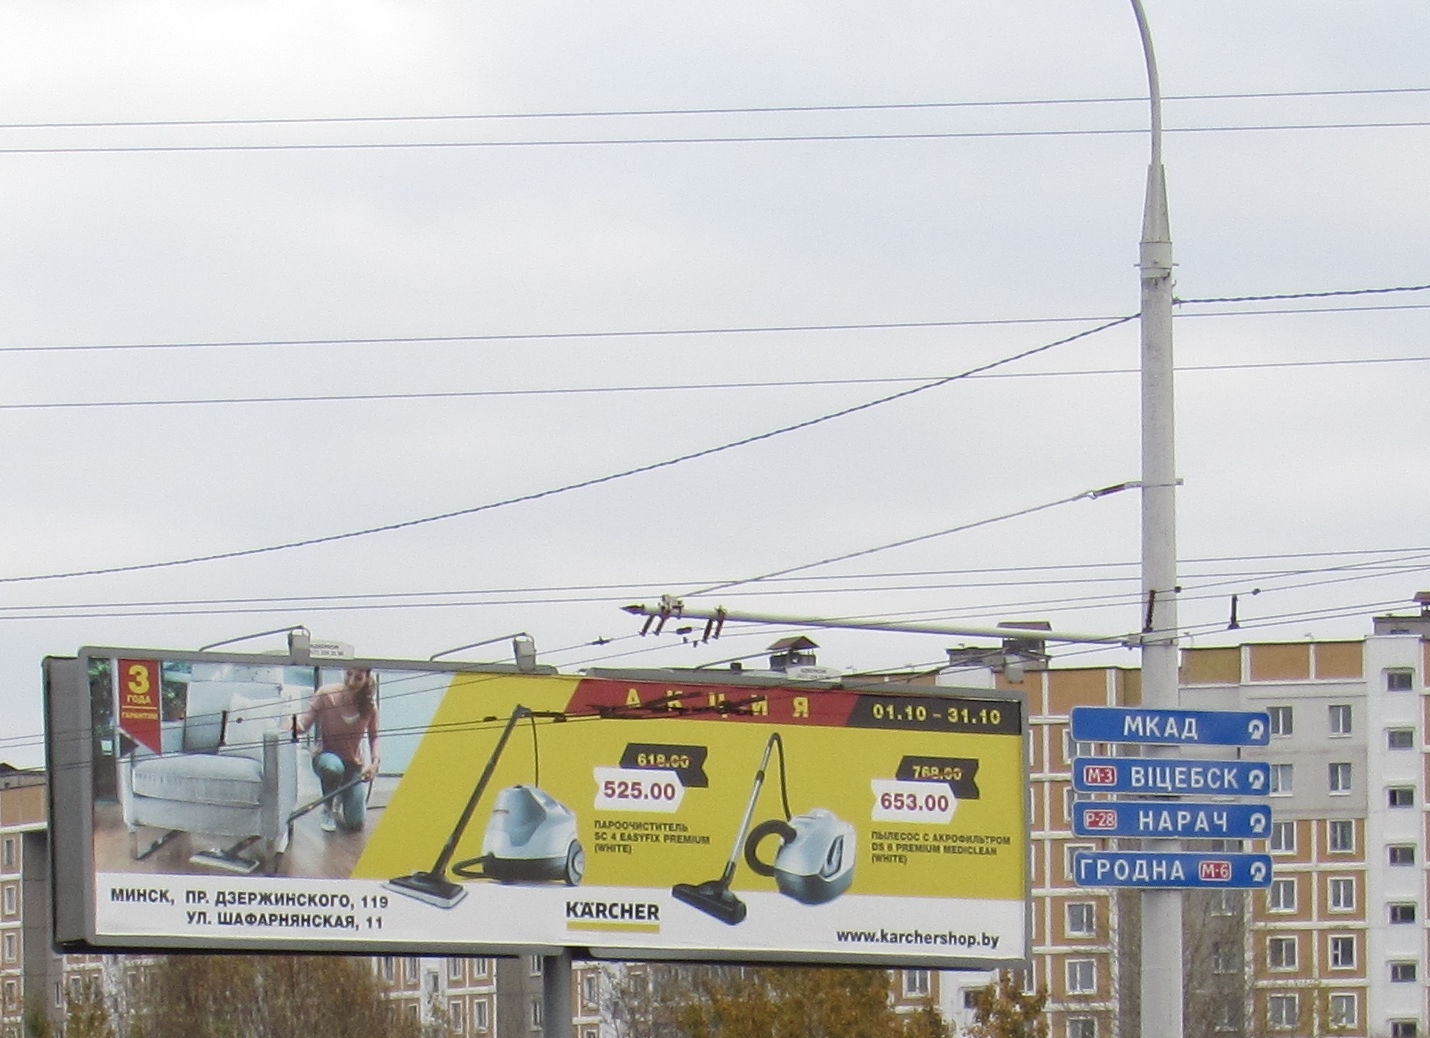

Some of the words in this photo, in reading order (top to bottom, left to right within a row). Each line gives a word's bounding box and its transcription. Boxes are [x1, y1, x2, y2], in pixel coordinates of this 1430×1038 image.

[127, 664, 150, 694] 3
[126, 694, 152, 705] ГОДА
[872, 703, 927, 722] 01.10
[947, 707, 1001, 724] 31.10
[1123, 715, 1199, 740] МКАД
[1087, 768, 1113, 783] М-3
[1130, 766, 1239, 791] ВІЦЕБСК
[603, 780, 676, 801] 525.00
[880, 792, 949, 812] 653.00
[594, 820, 689, 833] ПАРООЧИСТИТЕЛЬ
[1086, 812, 1115, 827] Р-28
[1138, 810, 1229, 833] НАРАЧ
[1079, 857, 1186, 883] ГРОДНА
[1201, 864, 1229, 878] М-6
[110, 887, 176, 905] МИНСК,
[184, 890, 210, 905] ПР.
[214, 891, 356, 910] ДЗЕРЖИНСКОГО,
[360, 895, 389, 909] 119
[186, 911, 212, 926] УЛ.
[216, 912, 360, 931] ШАФАРНЯНСКАЯ,
[365, 916, 383, 930] 11
[566, 899, 660, 921] KÄRCHER
[836, 928, 1000, 950] www.karchershop.by
